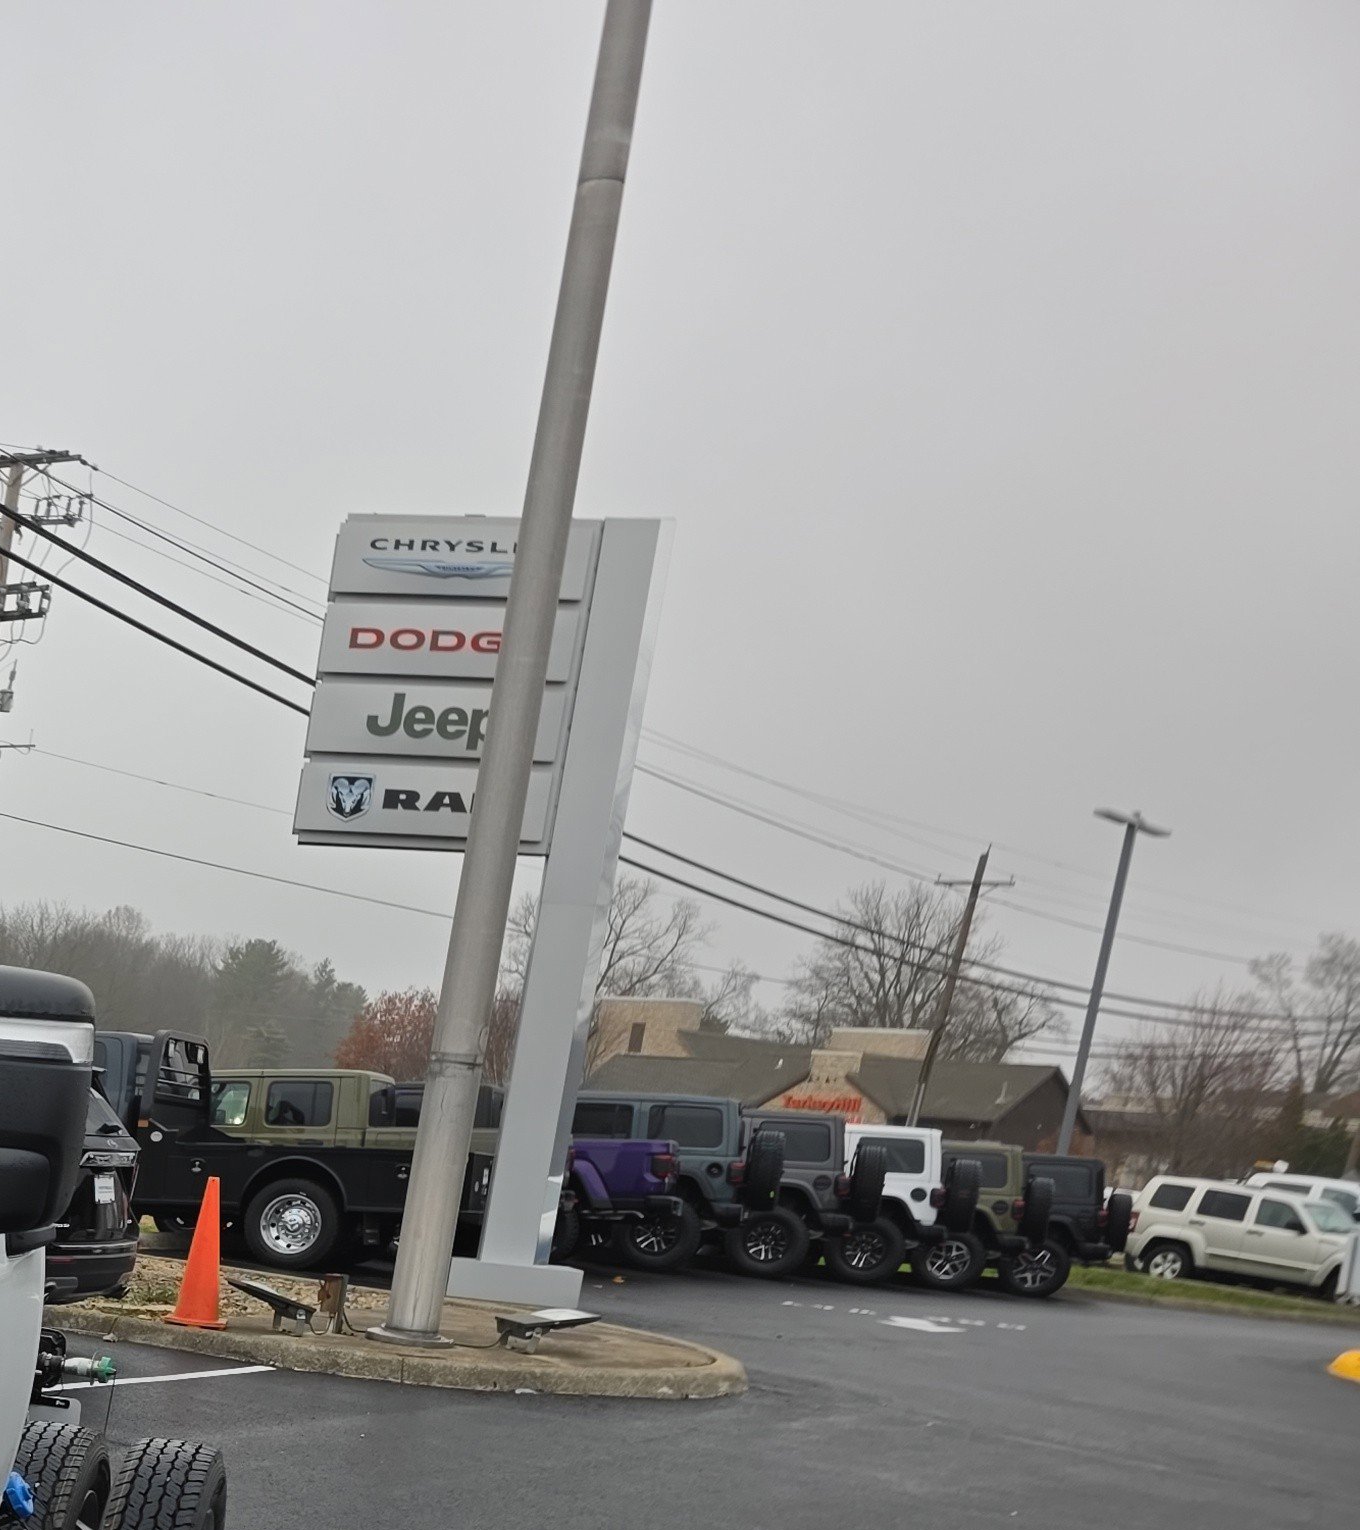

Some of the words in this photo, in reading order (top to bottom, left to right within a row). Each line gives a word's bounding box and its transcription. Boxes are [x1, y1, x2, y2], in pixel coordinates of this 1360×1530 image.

[369, 538, 517, 553] CHRYSL
[348, 627, 502, 653] DODG
[382, 788, 476, 814] RA
